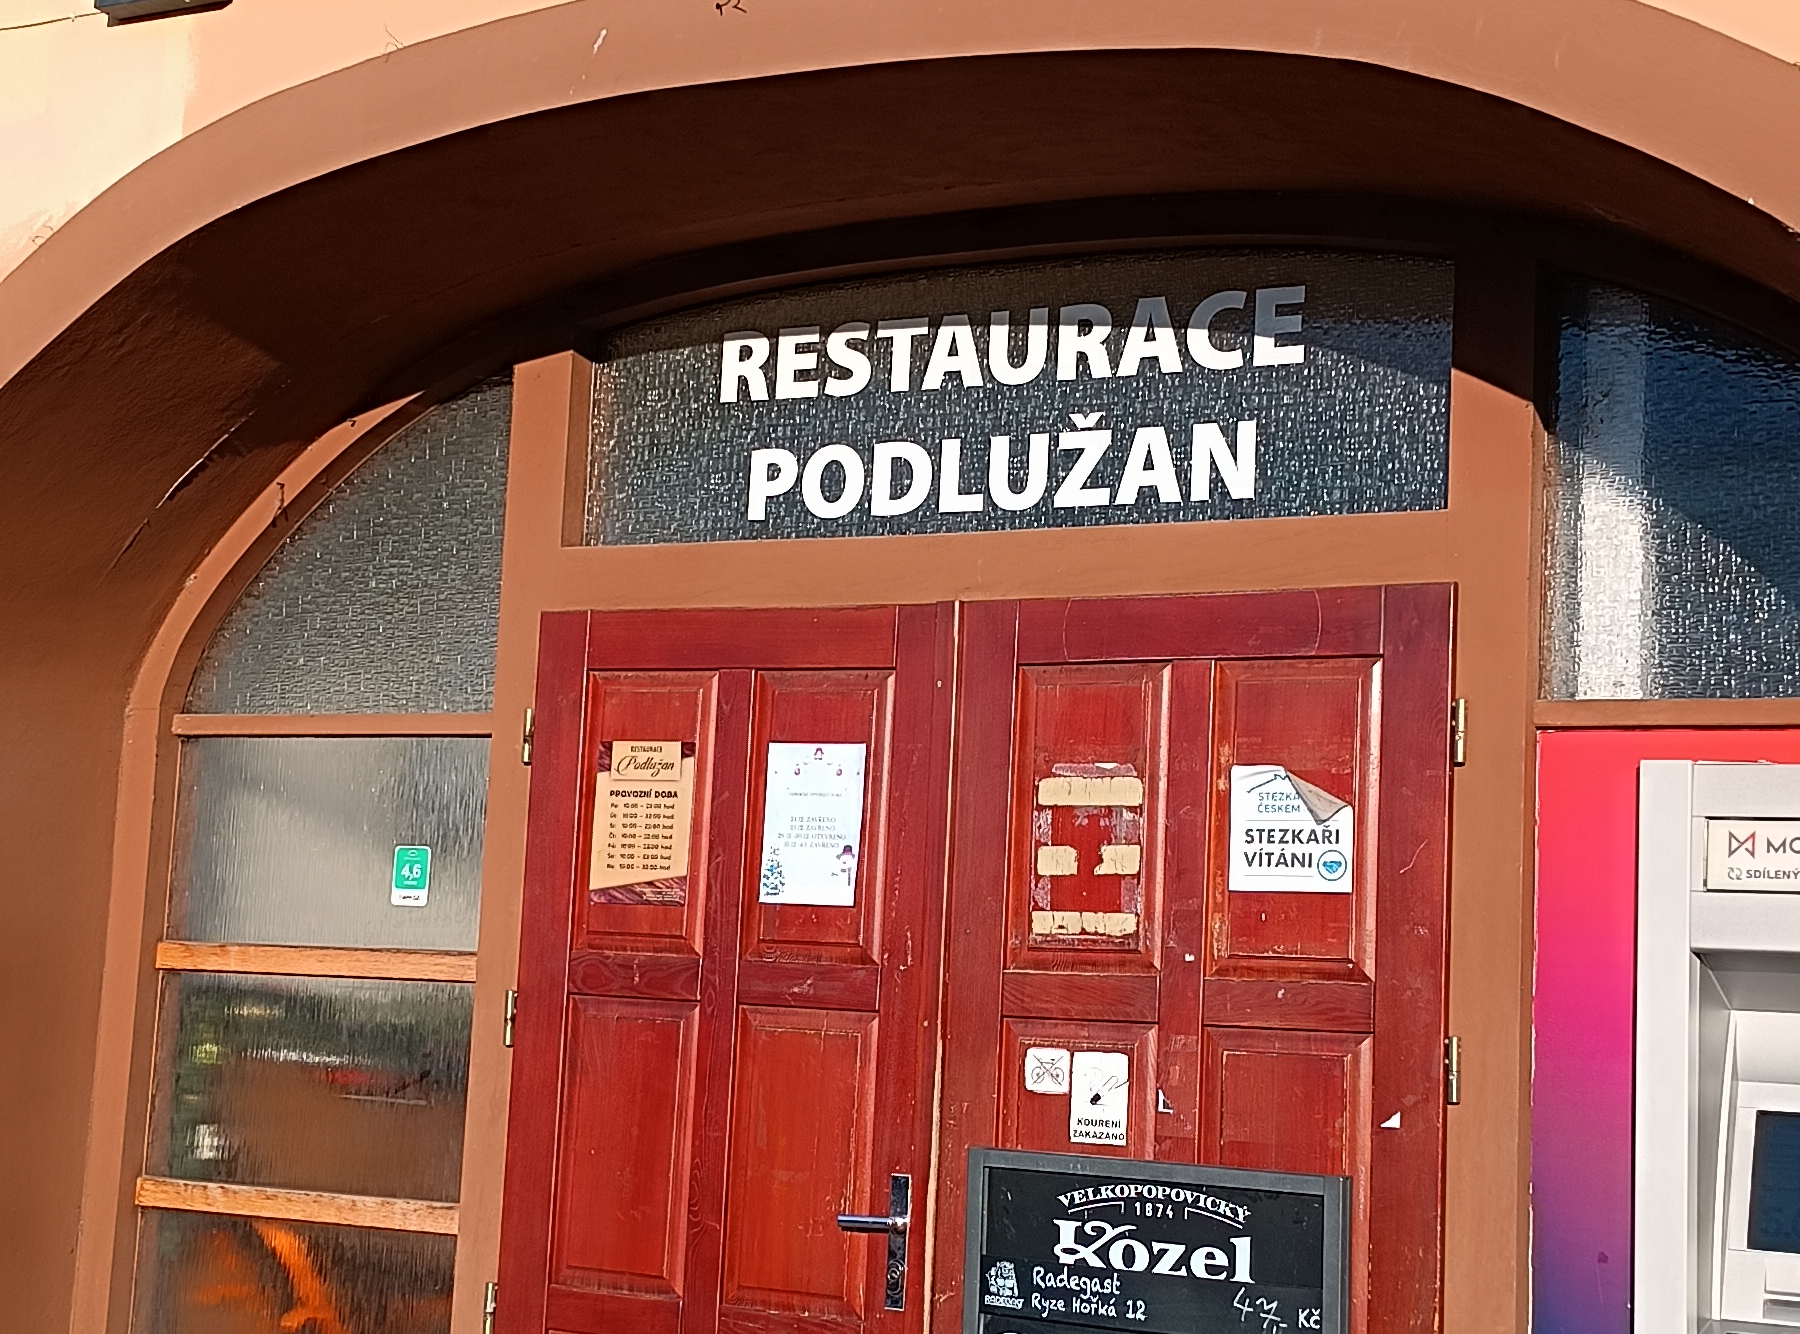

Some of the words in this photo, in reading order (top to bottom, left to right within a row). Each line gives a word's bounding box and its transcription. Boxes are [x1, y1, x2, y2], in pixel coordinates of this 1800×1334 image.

[718, 284, 1306, 404] RESTAURACE
[747, 412, 1258, 522] PODLUŽAN
[609, 788, 653, 799] PROVOZNÍ
[654, 790, 679, 799] DOBA
[1258, 792, 1301, 802] STEZKA
[1257, 802, 1301, 814] ČESKEM
[1244, 825, 1340, 845] STEZKAŘI
[1243, 847, 1313, 869] VÍTÁNI
[400, 863, 422, 881] 4,6
[1745, 866, 1800, 880] SDÍLENÝ
[1134, 1201, 1174, 1219] 1874
[1052, 1218, 1256, 1284] Kozel
[1032, 1265, 1121, 1300] Radegast
[1031, 1292, 1066, 1318] Ryze
[1072, 1295, 1118, 1318] Hořká
[1125, 1299, 1148, 1321] 12
[1298, 1308, 1321, 1329] Kč
